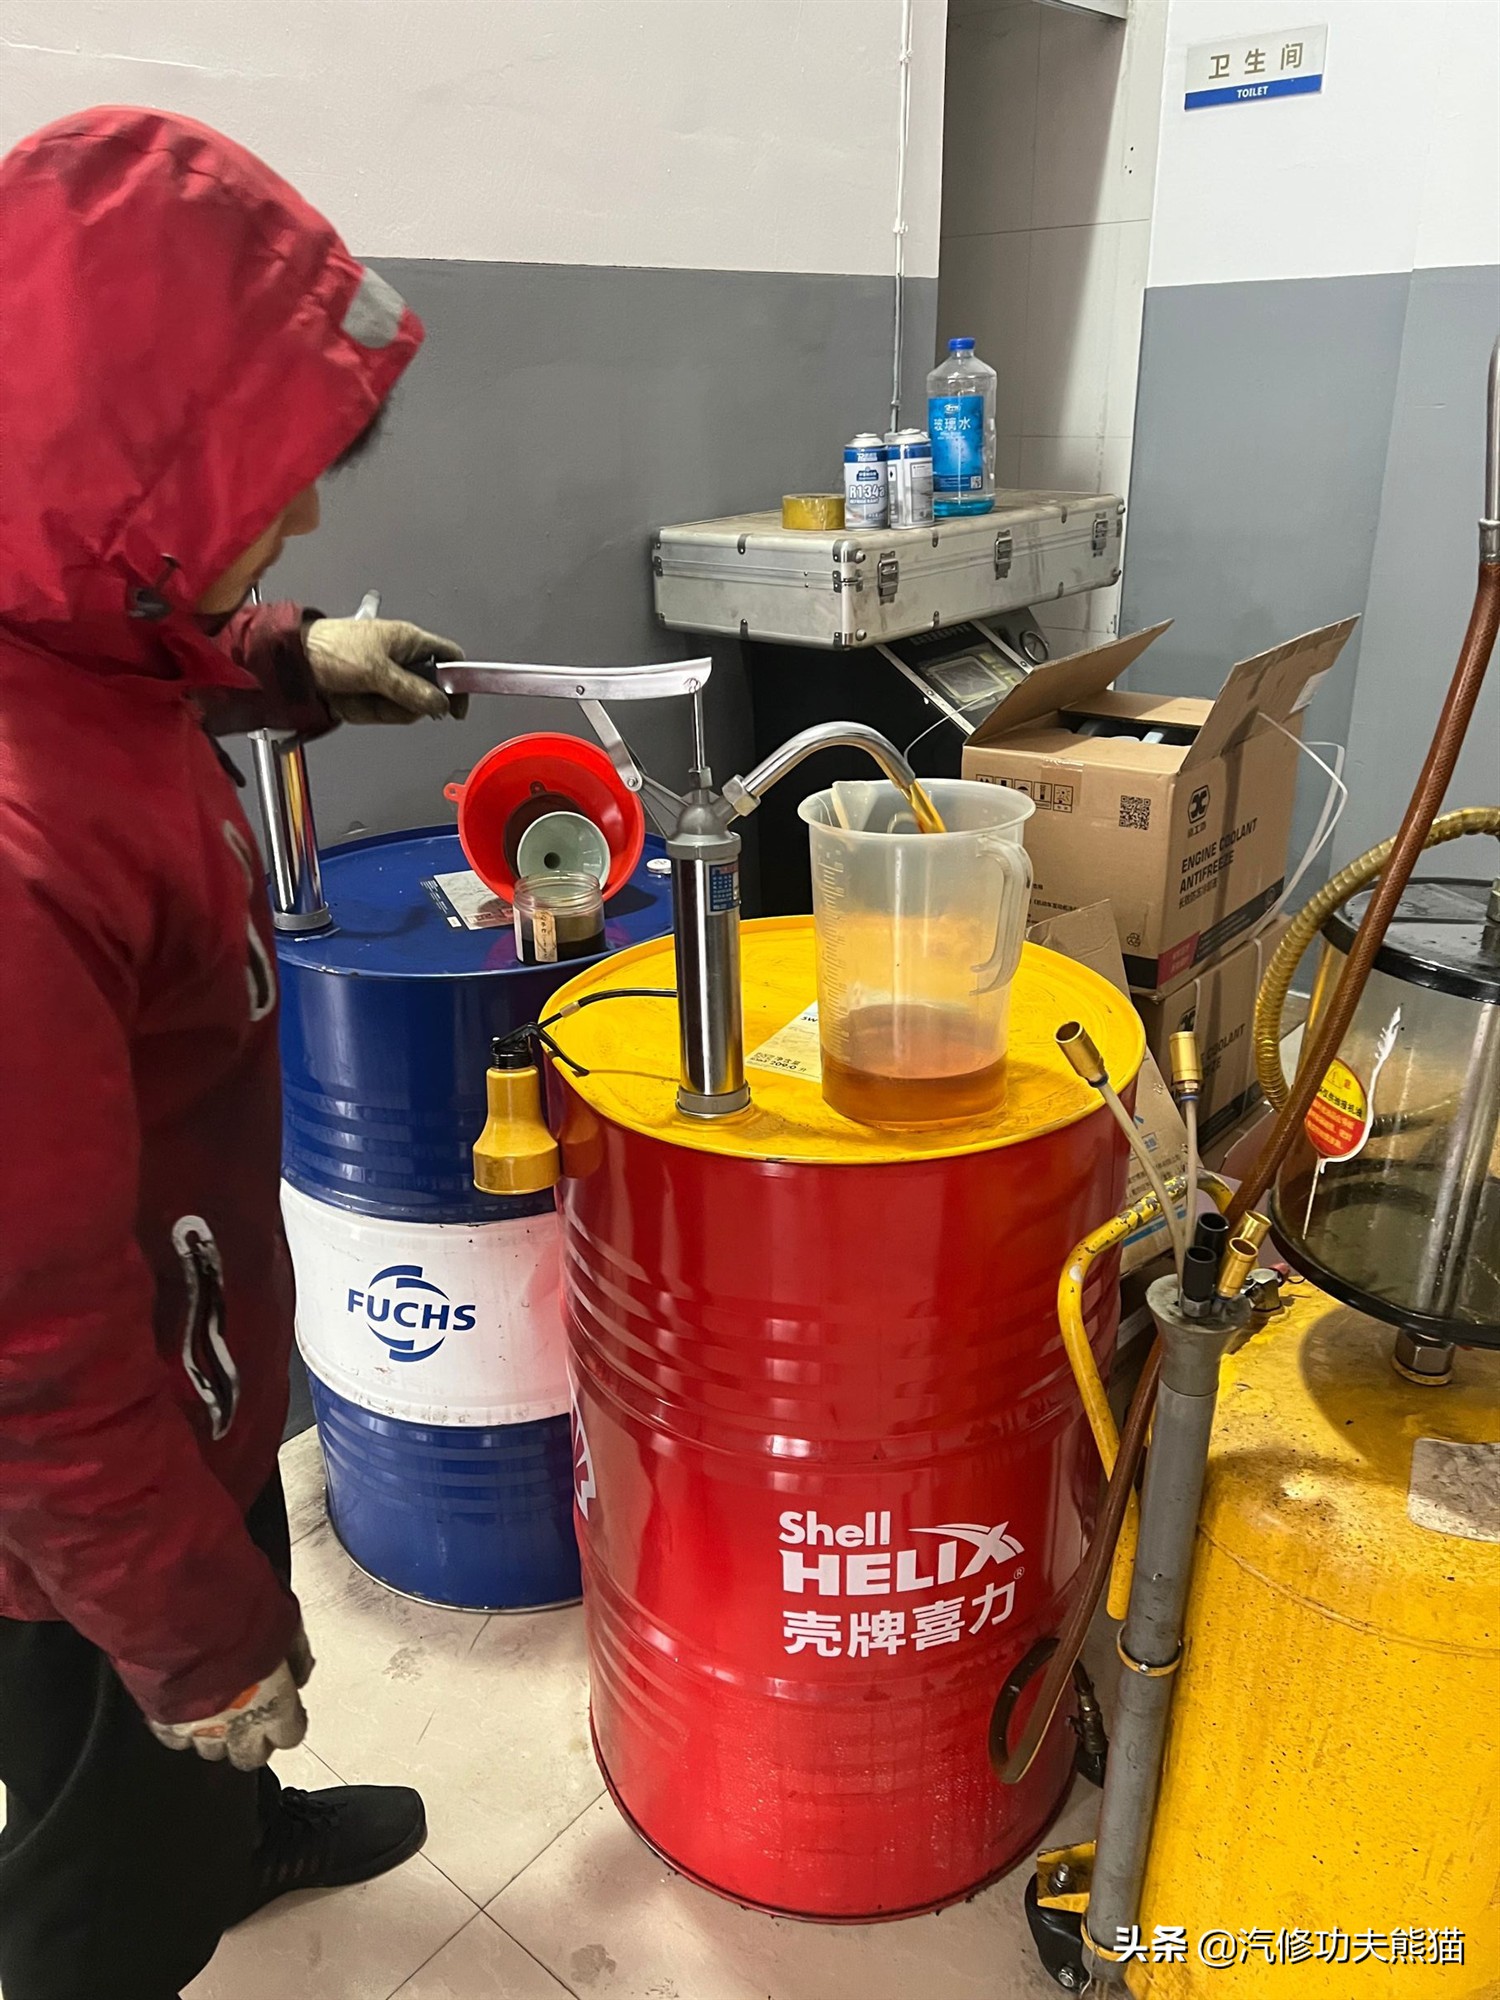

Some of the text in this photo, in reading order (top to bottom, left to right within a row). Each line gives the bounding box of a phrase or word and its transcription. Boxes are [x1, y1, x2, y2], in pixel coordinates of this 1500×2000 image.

[1208, 42, 1304, 80] 卫生间
[1236, 85, 1269, 99] TOILET
[933, 416, 972, 431] 玻璃水
[849, 484, 885, 499] R134a
[1181, 841, 1217, 874] ENGINE
[1218, 817, 1258, 851] COOLANT
[1179, 850, 1235, 894] ANTIFREEZE
[347, 1288, 477, 1331] FUCHS
[778, 1510, 891, 1548] Shell
[778, 1520, 1026, 1597] HELIX
[782, 1580, 1017, 1659] 壳牌喜力
